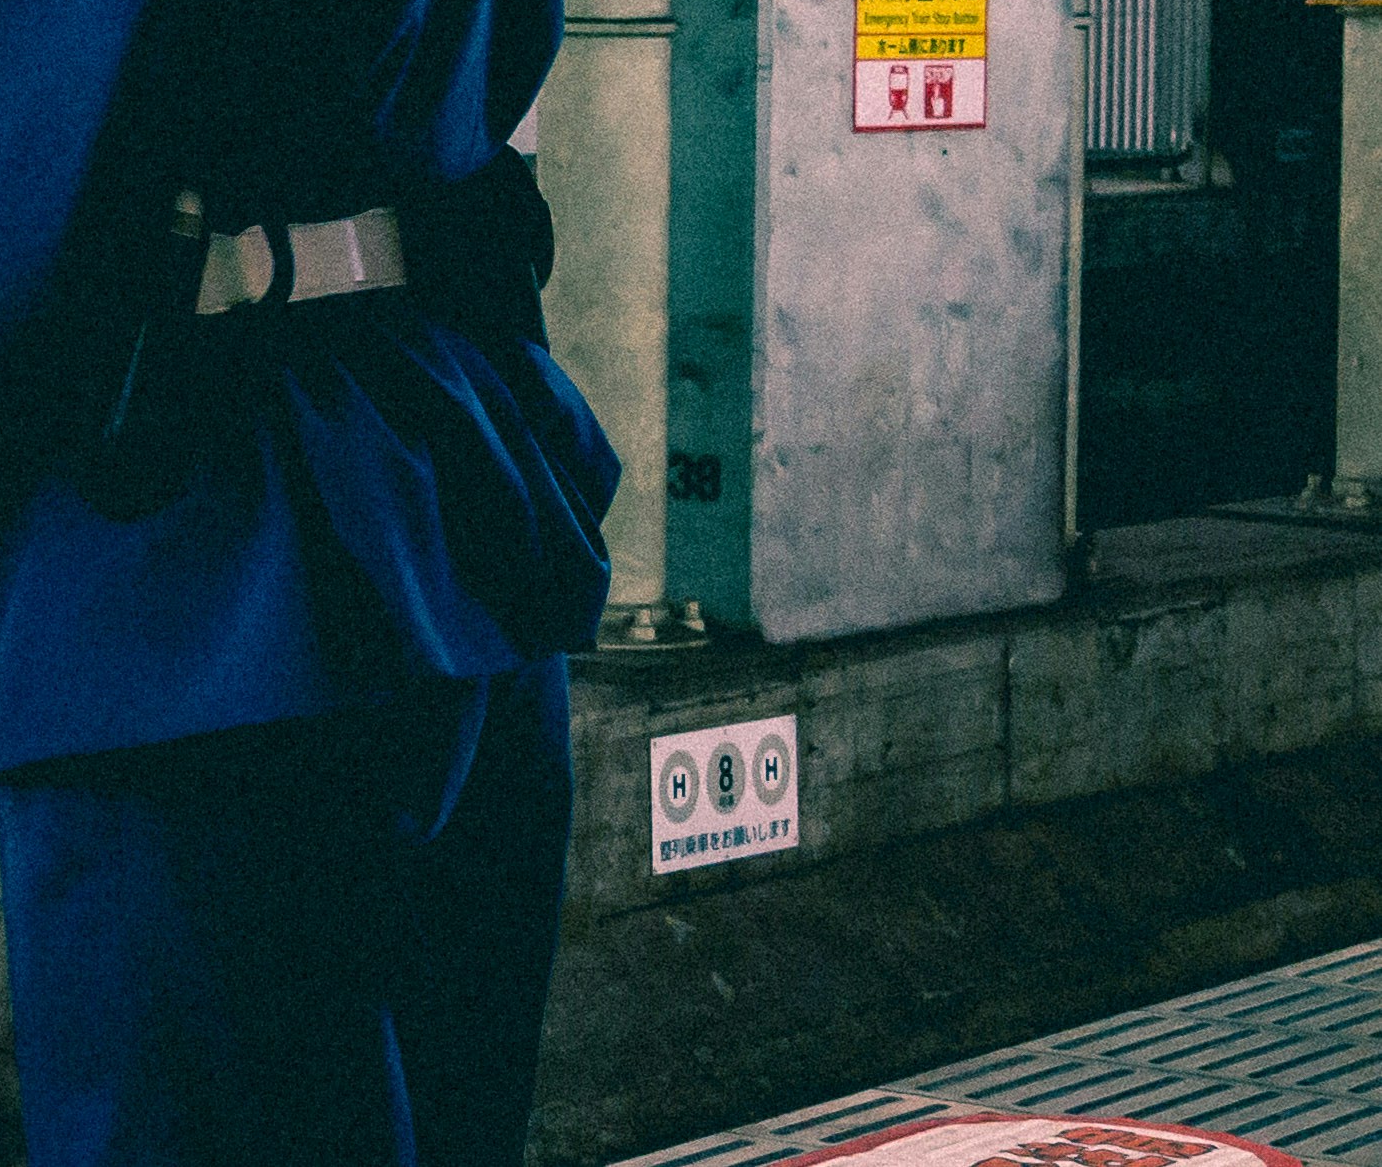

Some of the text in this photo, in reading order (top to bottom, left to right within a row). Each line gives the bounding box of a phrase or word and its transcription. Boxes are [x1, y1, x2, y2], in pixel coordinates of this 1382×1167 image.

[668, 453, 721, 503] 38
[673, 754, 778, 799] H 8 H
